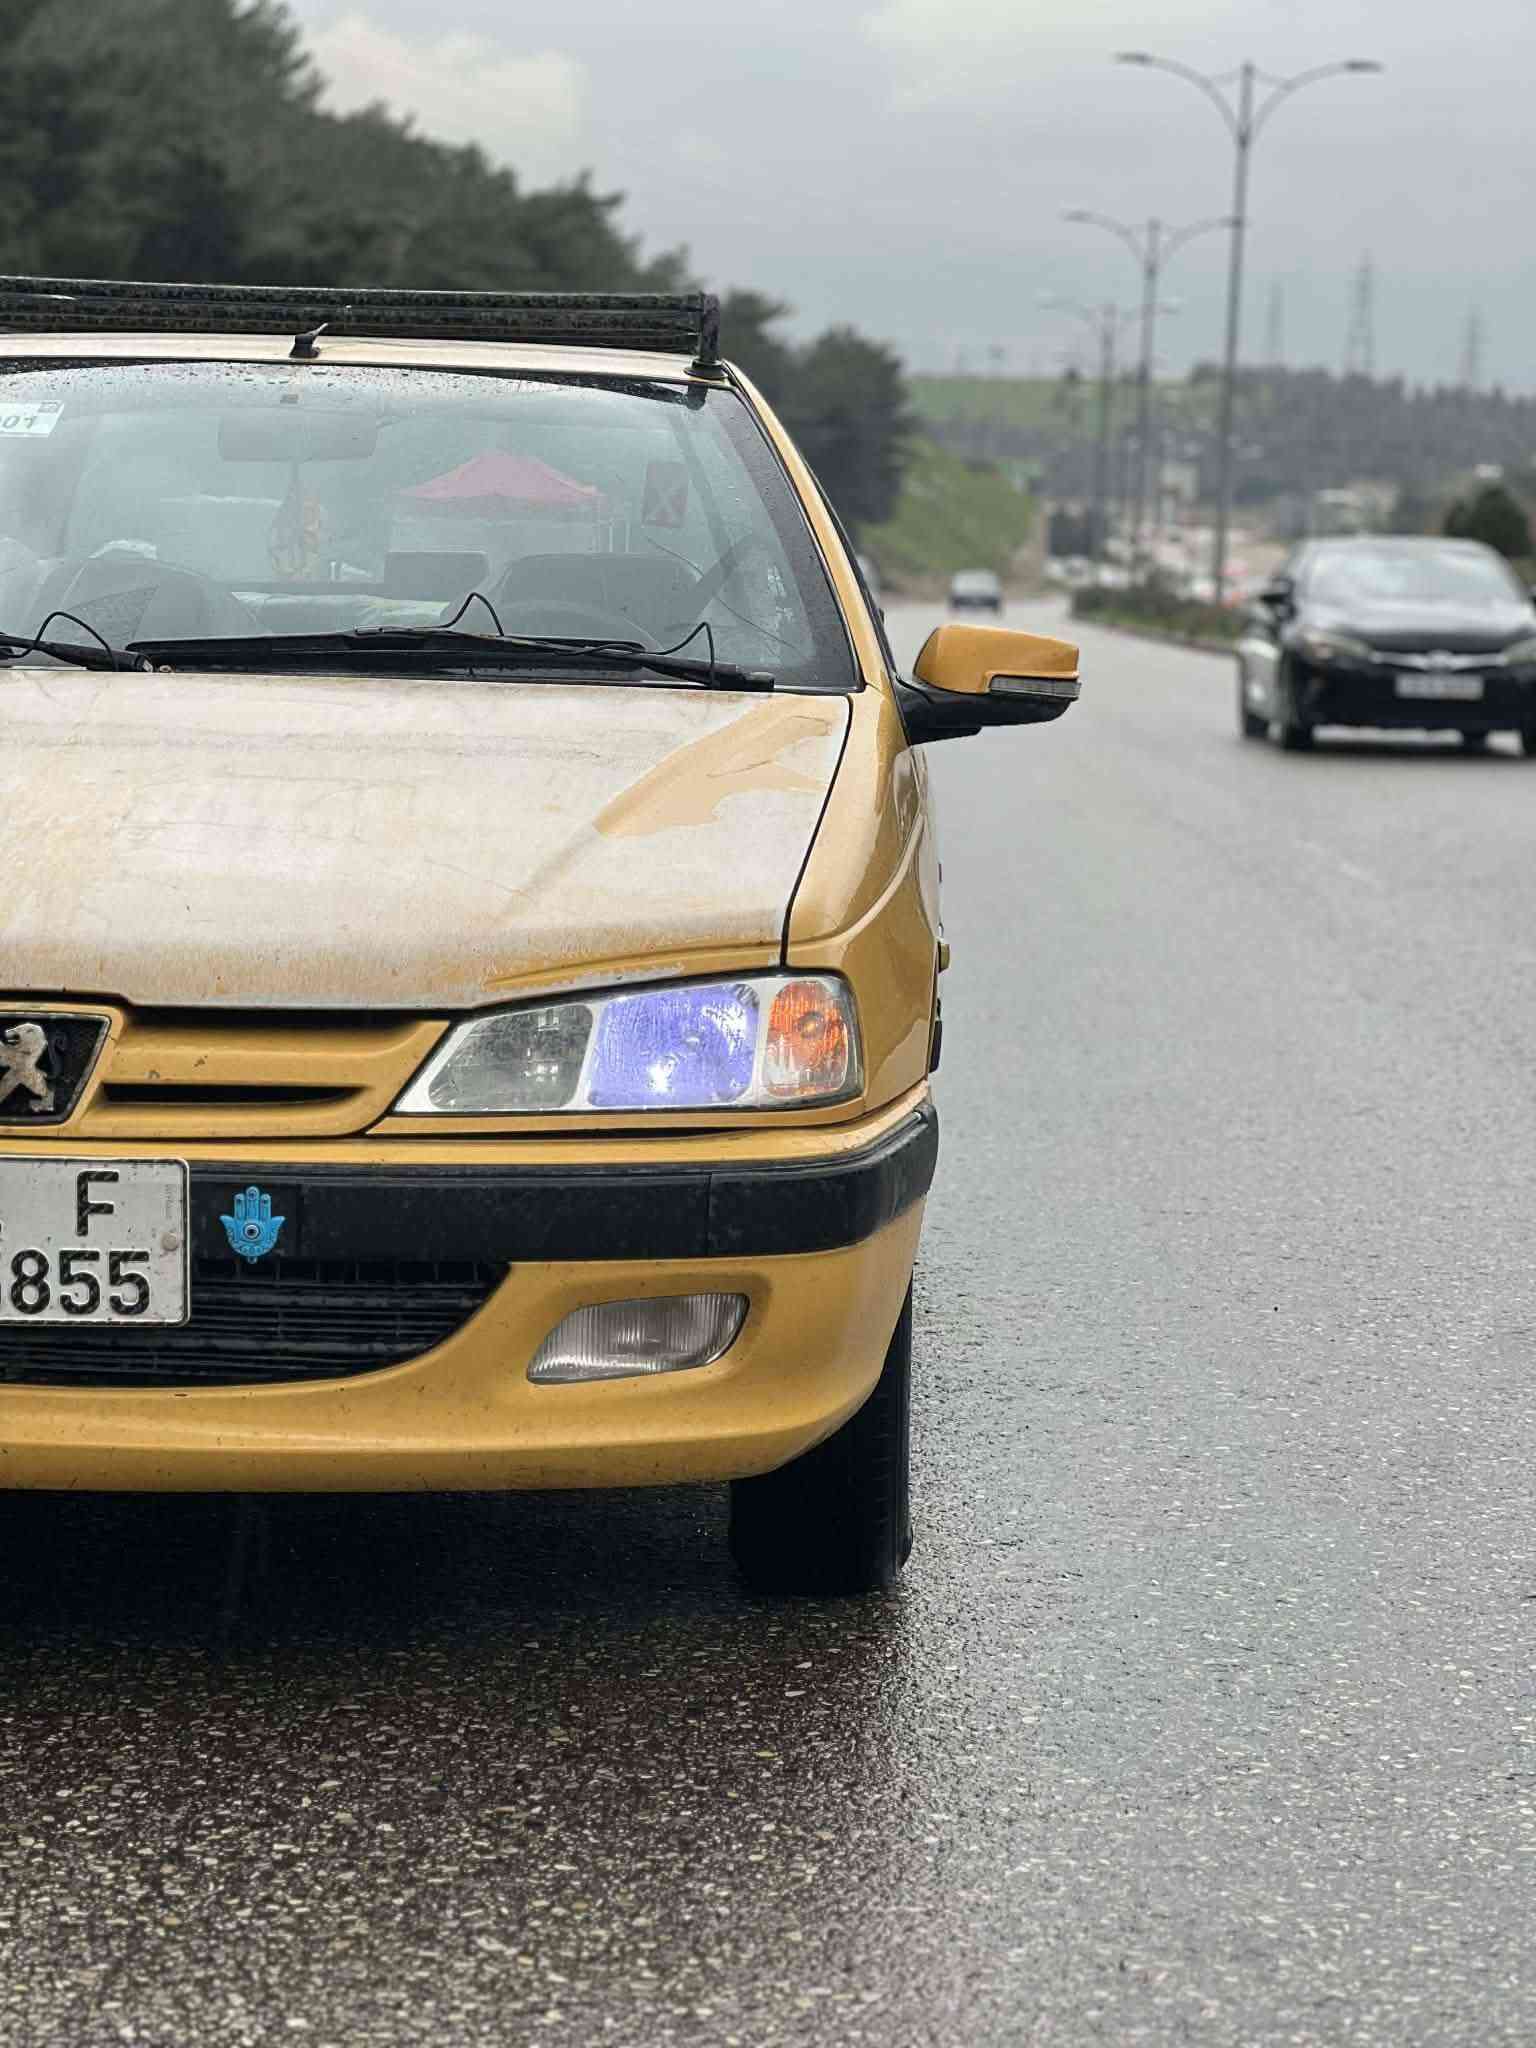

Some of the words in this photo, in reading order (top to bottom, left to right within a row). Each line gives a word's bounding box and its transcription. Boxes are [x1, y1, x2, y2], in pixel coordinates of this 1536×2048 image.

[0, 415, 37, 430] 01
[76, 1170, 119, 1236] F
[0, 1249, 150, 1314] 855
